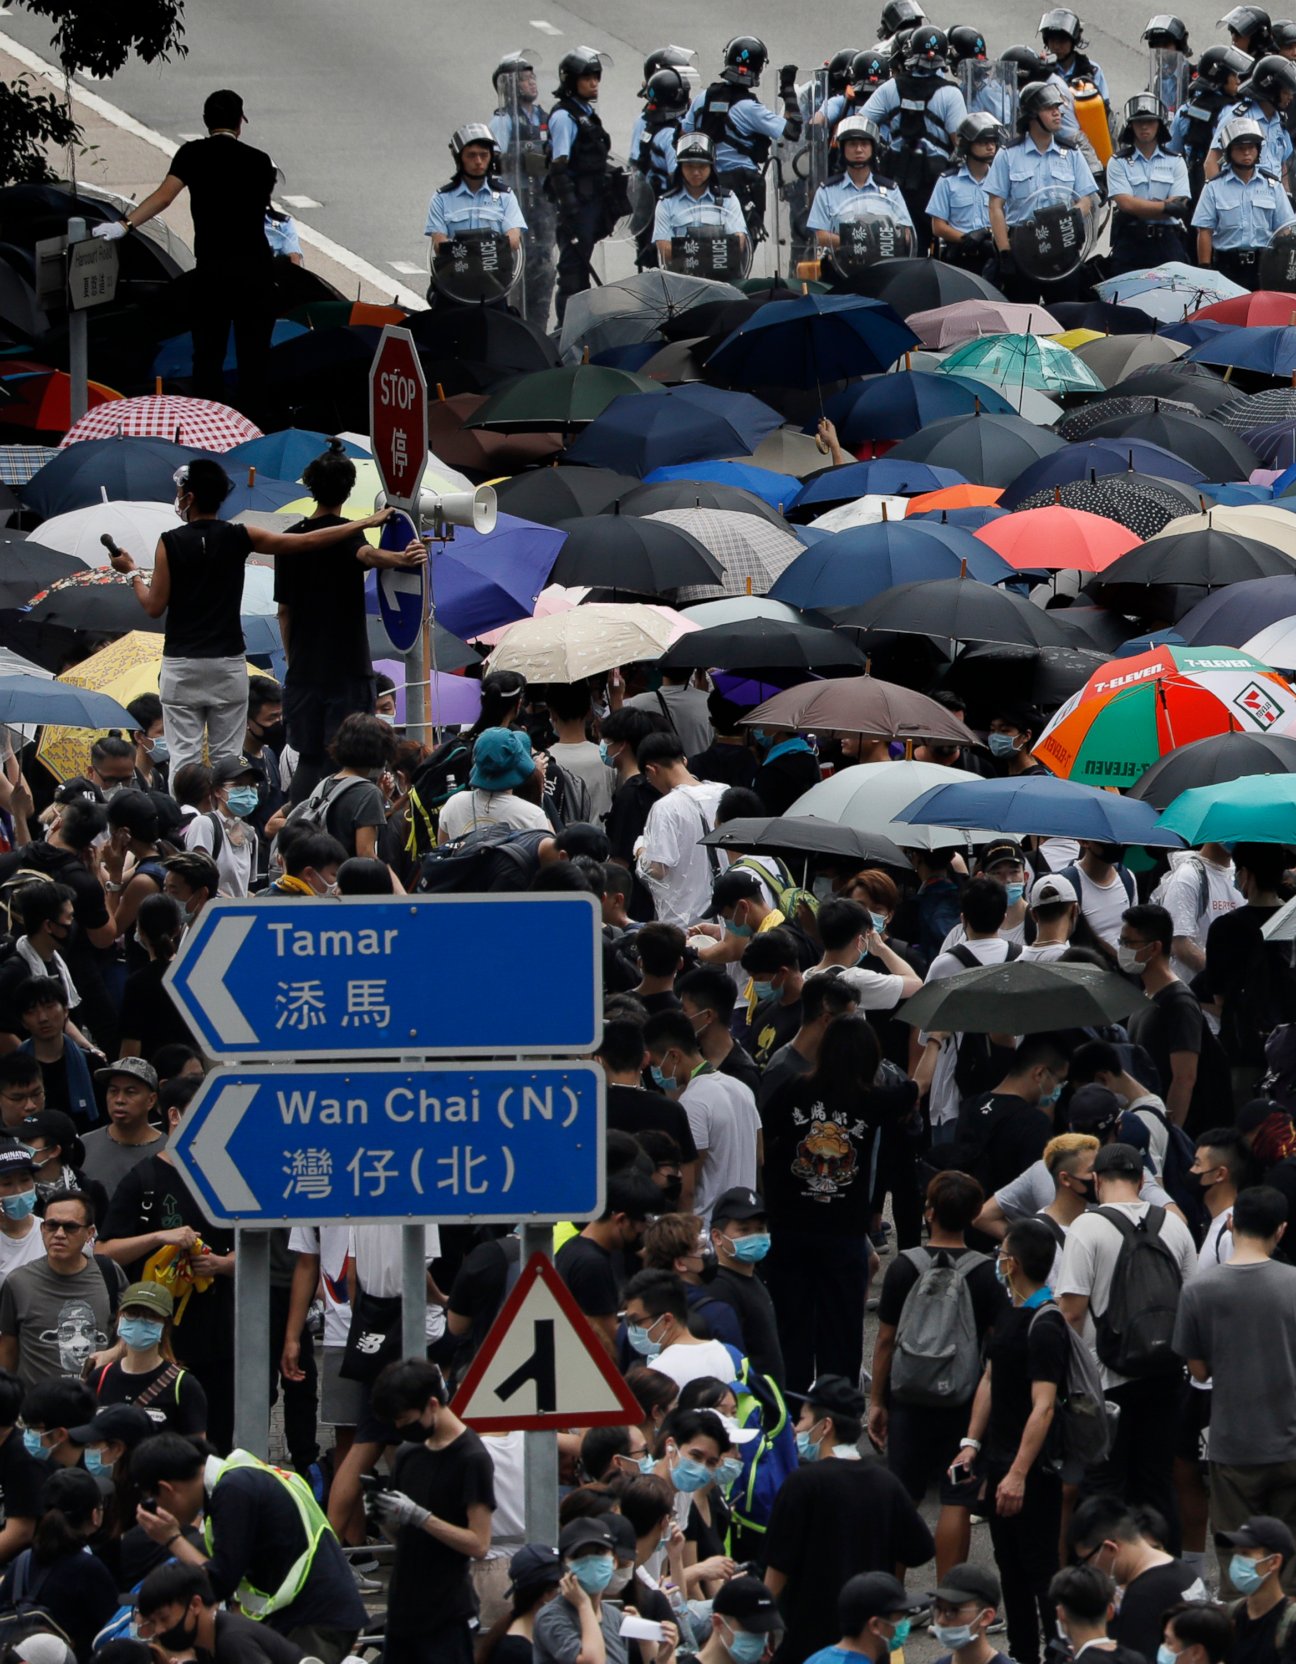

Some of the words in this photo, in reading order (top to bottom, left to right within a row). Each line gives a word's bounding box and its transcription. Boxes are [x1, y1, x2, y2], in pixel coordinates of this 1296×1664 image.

[880, 226, 896, 258] POLICE
[1059, 215, 1077, 249] POLICE
[451, 243, 469, 273] 警察
[481, 240, 499, 272] POLICE
[684, 239, 701, 270] 警察
[712, 238, 728, 270] POLICE
[380, 371, 416, 411] STOP
[390, 427, 408, 478] 停
[267, 923, 399, 957] Tamar
[275, 979, 391, 1030] 添馬
[276, 1090, 368, 1125] Wan
[384, 1087, 480, 1123] Chai
[497, 1085, 579, 1129] (N)
[281, 1145, 515, 1200] 灣仔(北)
